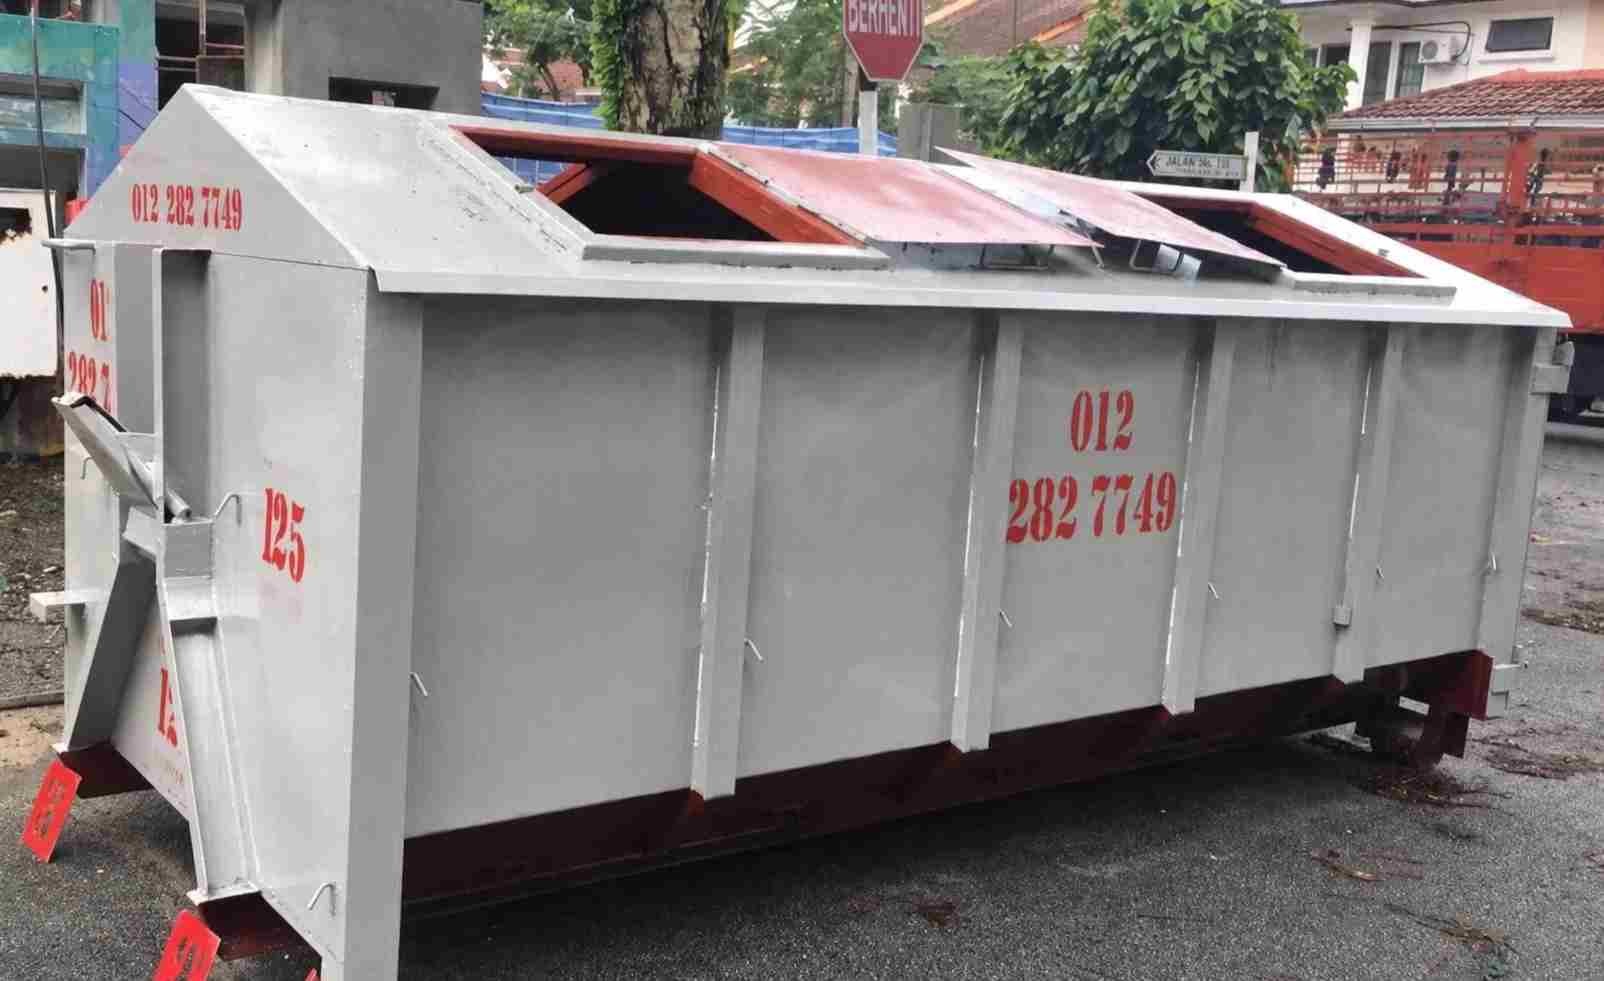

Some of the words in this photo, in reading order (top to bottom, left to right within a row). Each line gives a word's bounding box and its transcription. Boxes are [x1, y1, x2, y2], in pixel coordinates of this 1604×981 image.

[1166, 155, 1195, 169] JALAN
[132, 183, 158, 222] 012
[167, 184, 194, 226] 282
[201, 186, 242, 232] 7749
[90, 279, 112, 341] 01
[101, 361, 112, 414] 7
[1070, 388, 1135, 453] 012
[262, 487, 305, 584] 125
[1006, 474, 1078, 545] 282
[1091, 471, 1177, 538] 7749
